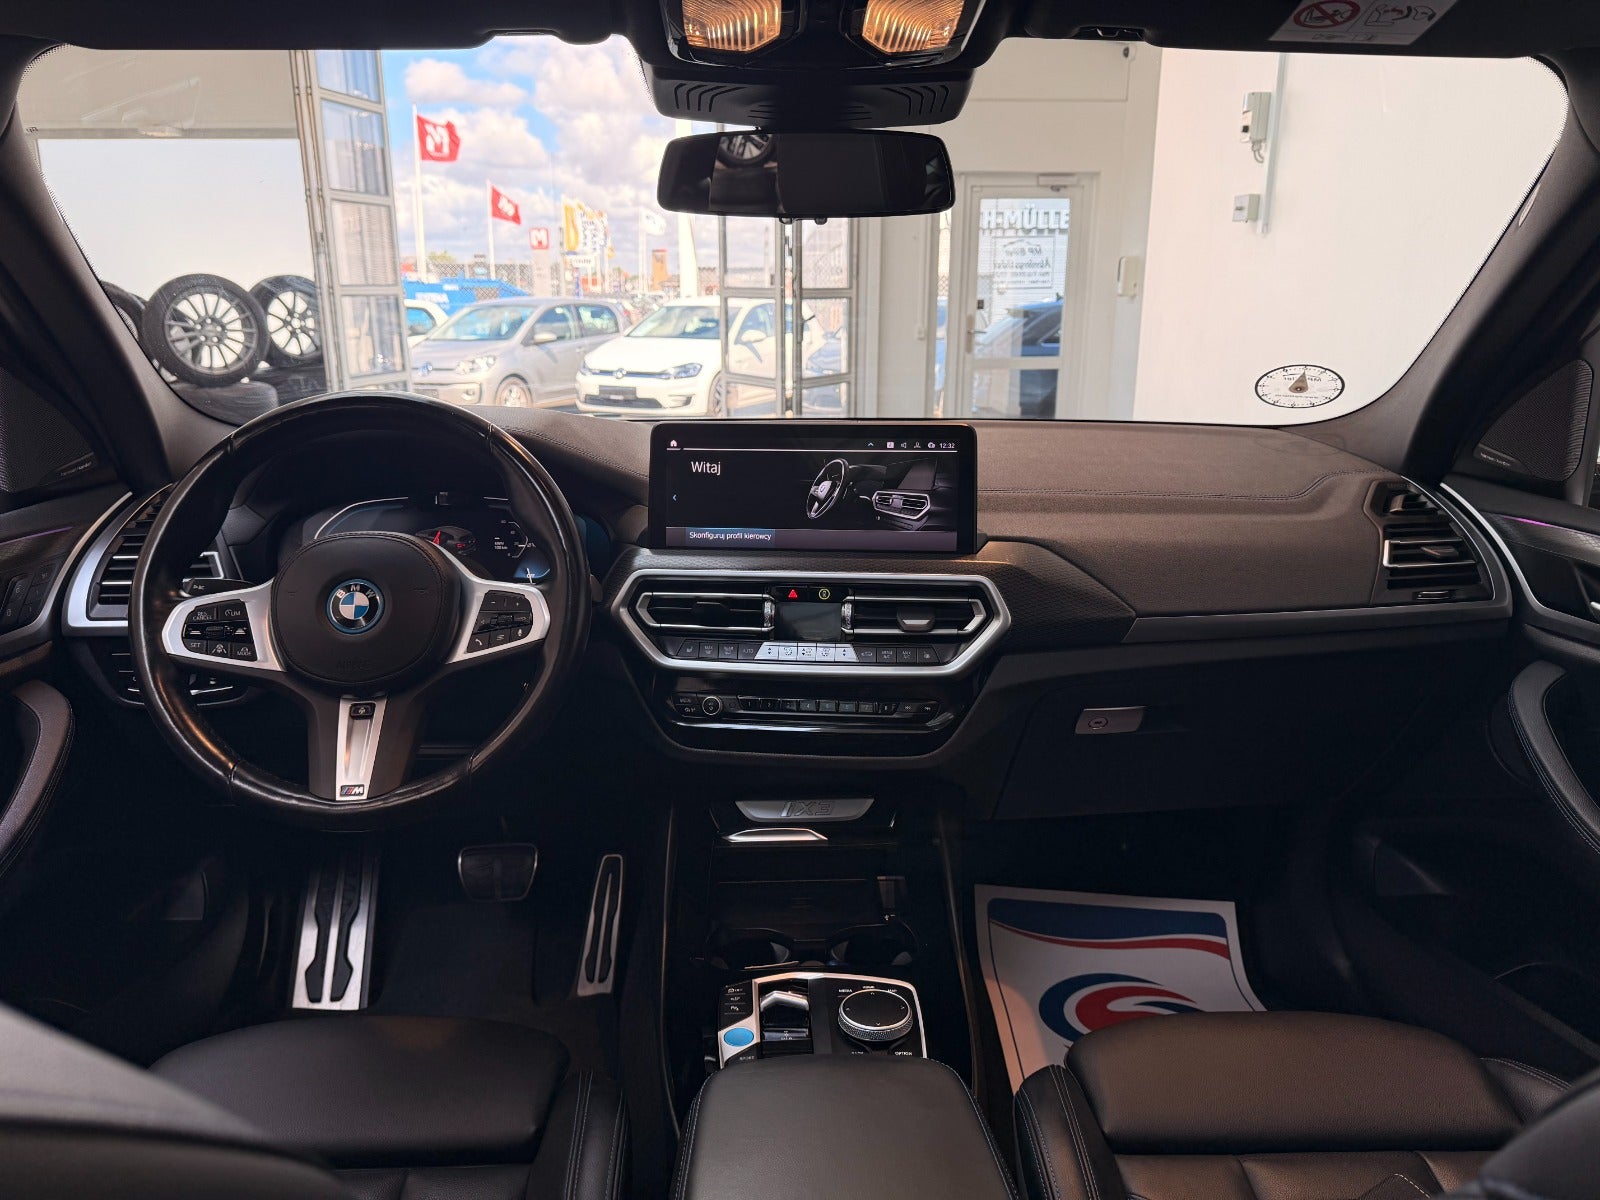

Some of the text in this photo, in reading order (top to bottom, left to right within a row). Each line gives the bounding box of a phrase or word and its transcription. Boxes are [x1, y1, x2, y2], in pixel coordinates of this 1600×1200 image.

[691, 461, 721, 476] Witaj
[689, 531, 772, 541] Skonfiguruj profil kierowcy
[336, 584, 376, 599] BMW
